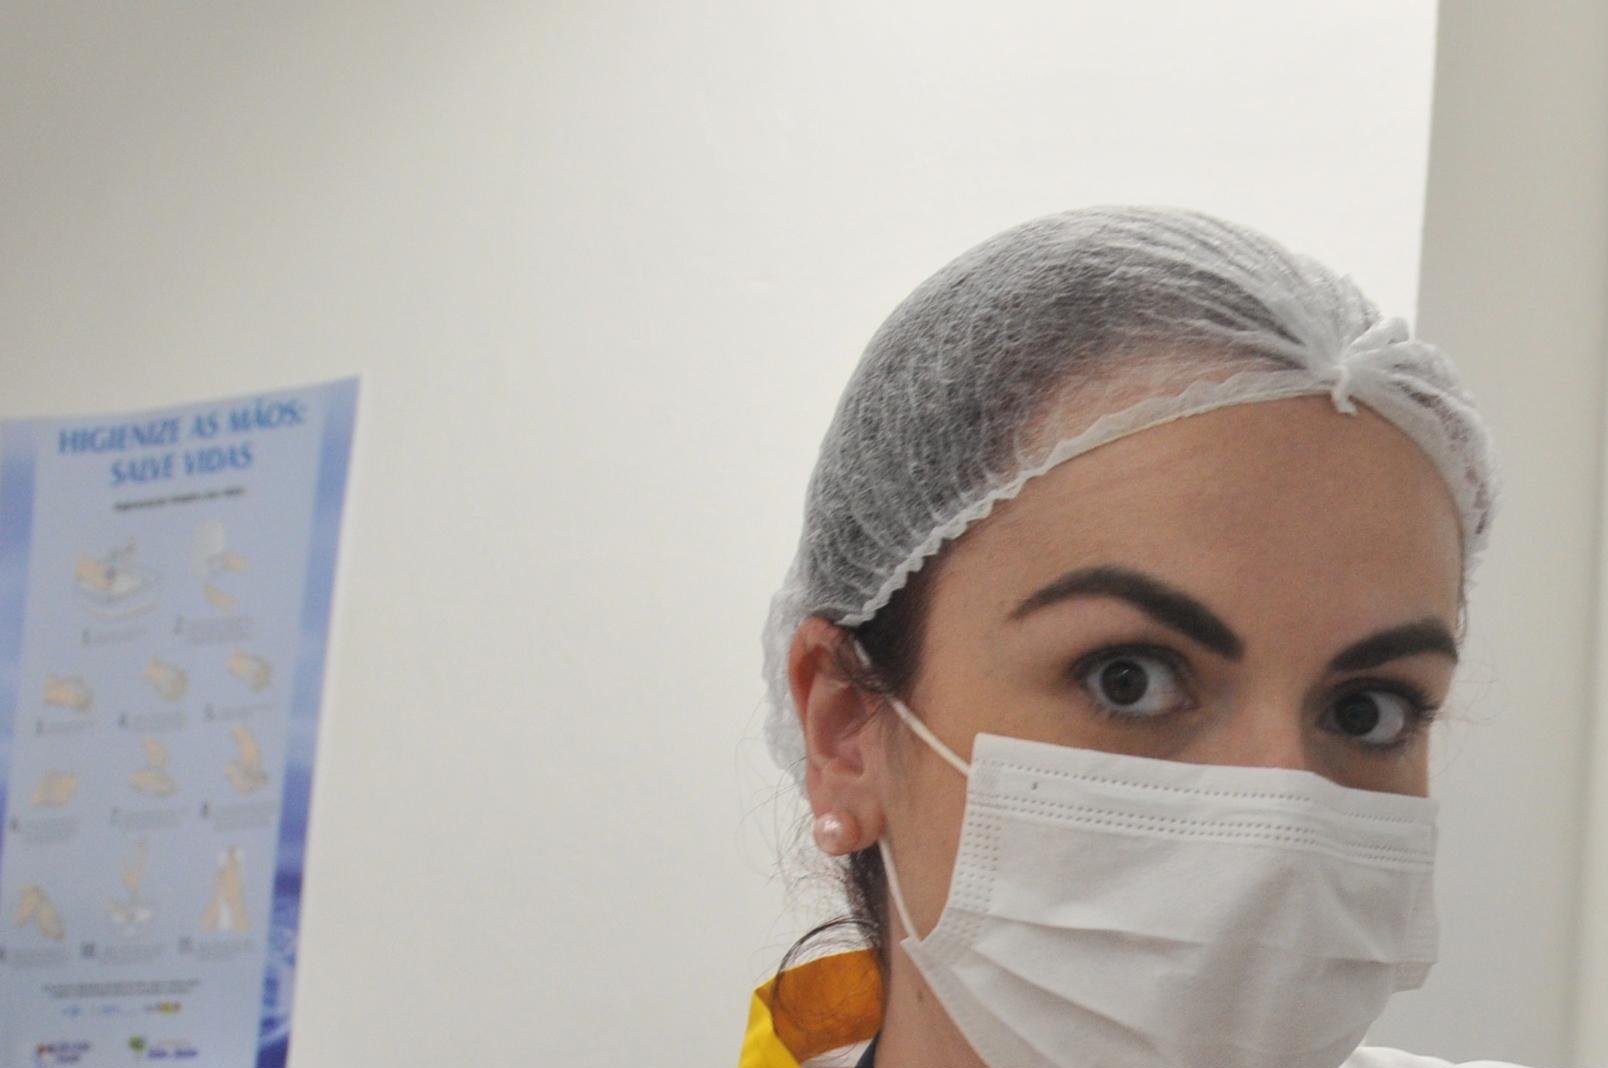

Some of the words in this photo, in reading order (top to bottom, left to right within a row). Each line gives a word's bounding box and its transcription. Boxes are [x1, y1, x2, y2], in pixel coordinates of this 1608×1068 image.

[57, 416, 181, 455] HIGIENIZE
[191, 412, 219, 439] AS
[109, 453, 174, 487] SALVE
[185, 440, 254, 475] VIDAS
